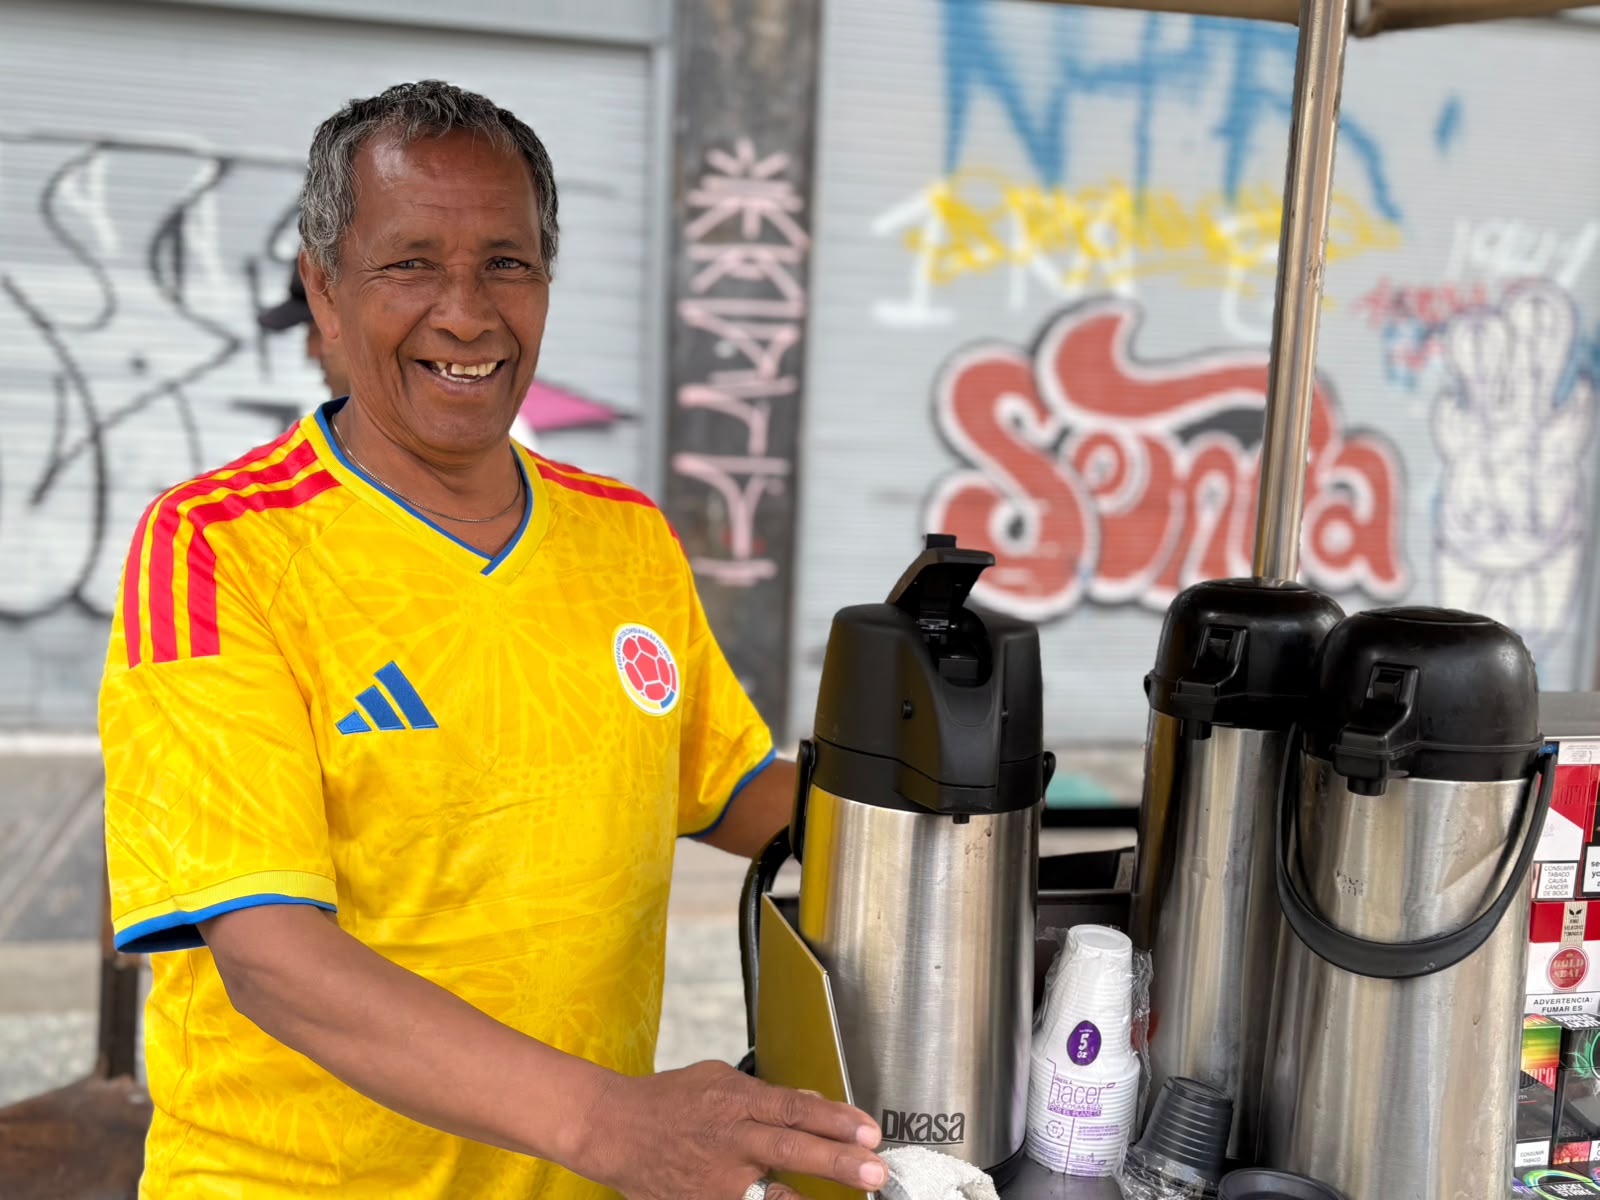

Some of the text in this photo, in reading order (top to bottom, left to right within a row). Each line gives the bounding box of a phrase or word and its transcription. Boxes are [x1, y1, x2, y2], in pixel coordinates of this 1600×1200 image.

[1533, 997, 1593, 1005] ADVERTENCIA:
[1078, 1033, 1090, 1051] 5
[882, 1109, 966, 1143] DKasa
